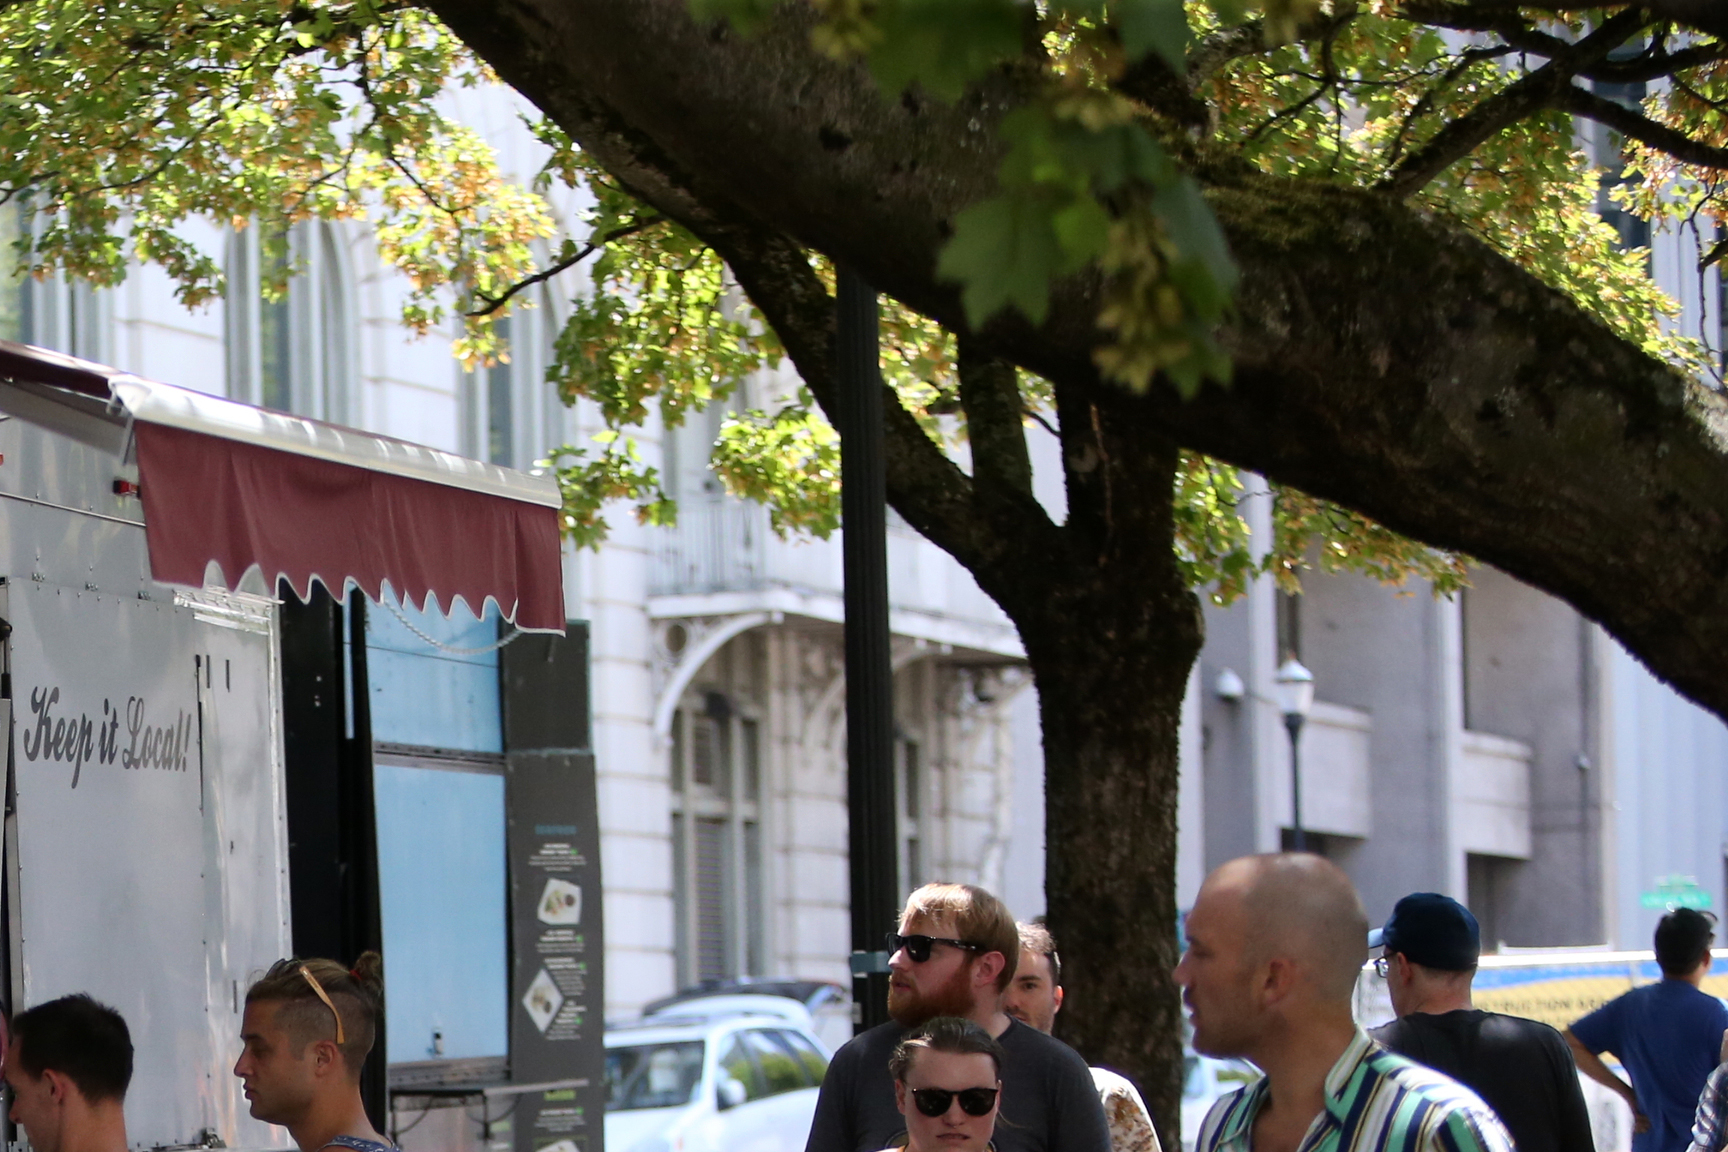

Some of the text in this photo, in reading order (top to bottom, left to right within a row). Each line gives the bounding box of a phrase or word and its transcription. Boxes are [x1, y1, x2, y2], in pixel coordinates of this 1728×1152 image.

[24, 686, 191, 788] Keep it Local!
